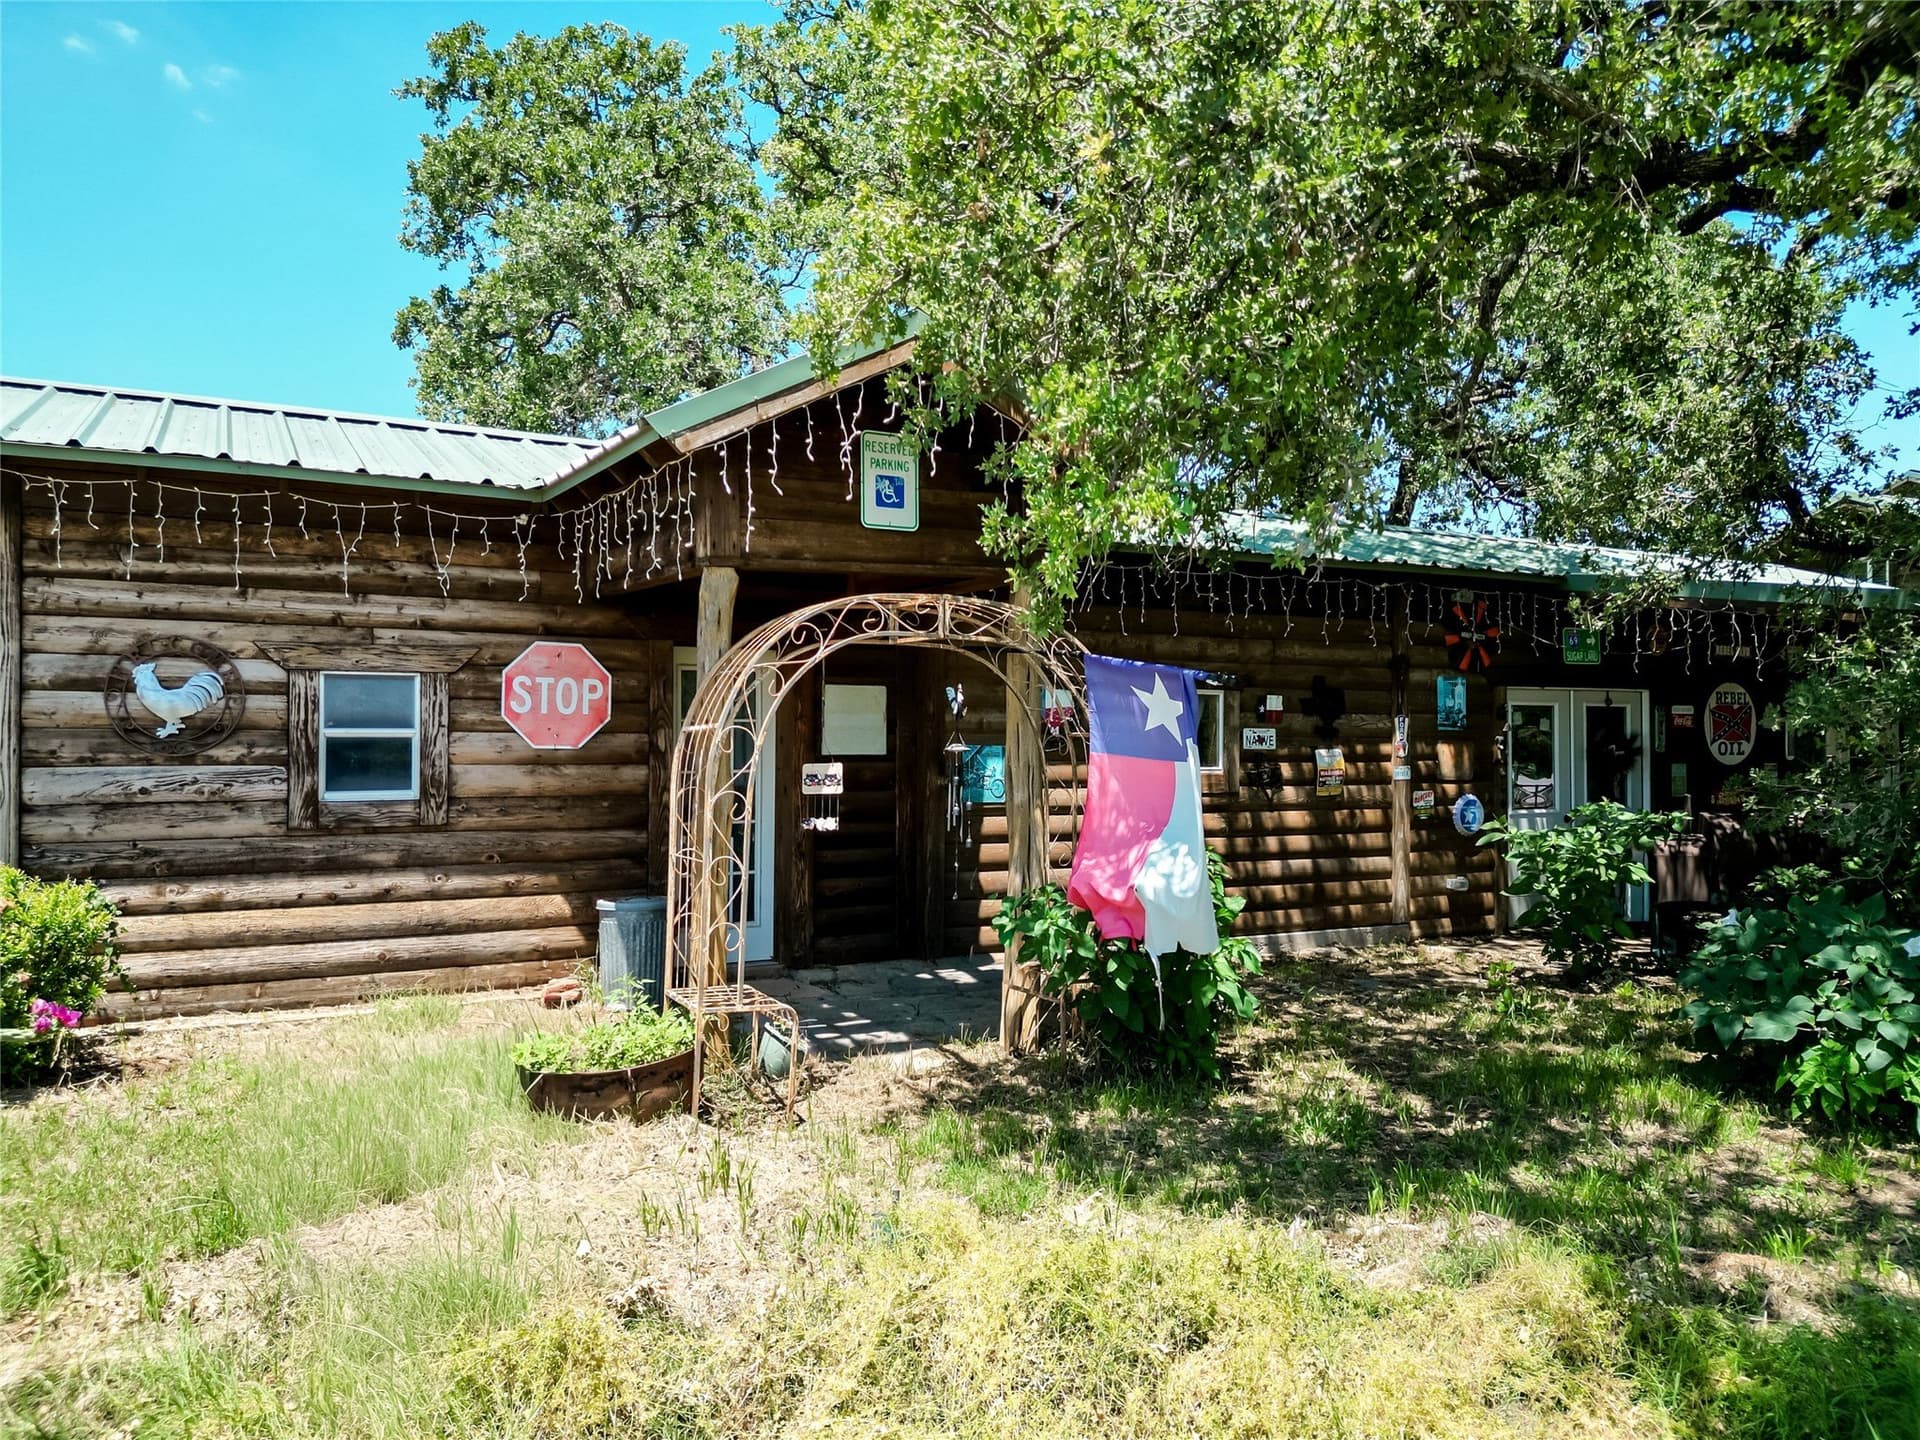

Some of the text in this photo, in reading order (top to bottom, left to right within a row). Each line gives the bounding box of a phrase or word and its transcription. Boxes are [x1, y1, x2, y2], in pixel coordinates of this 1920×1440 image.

[870, 457, 910, 472] PARKING
[1569, 636, 1578, 646] 69
[510, 675, 604, 715] STOP
[1715, 691, 1750, 705] REBEL
[1245, 735, 1275, 747] NAVE
[1718, 741, 1745, 756] OIL
